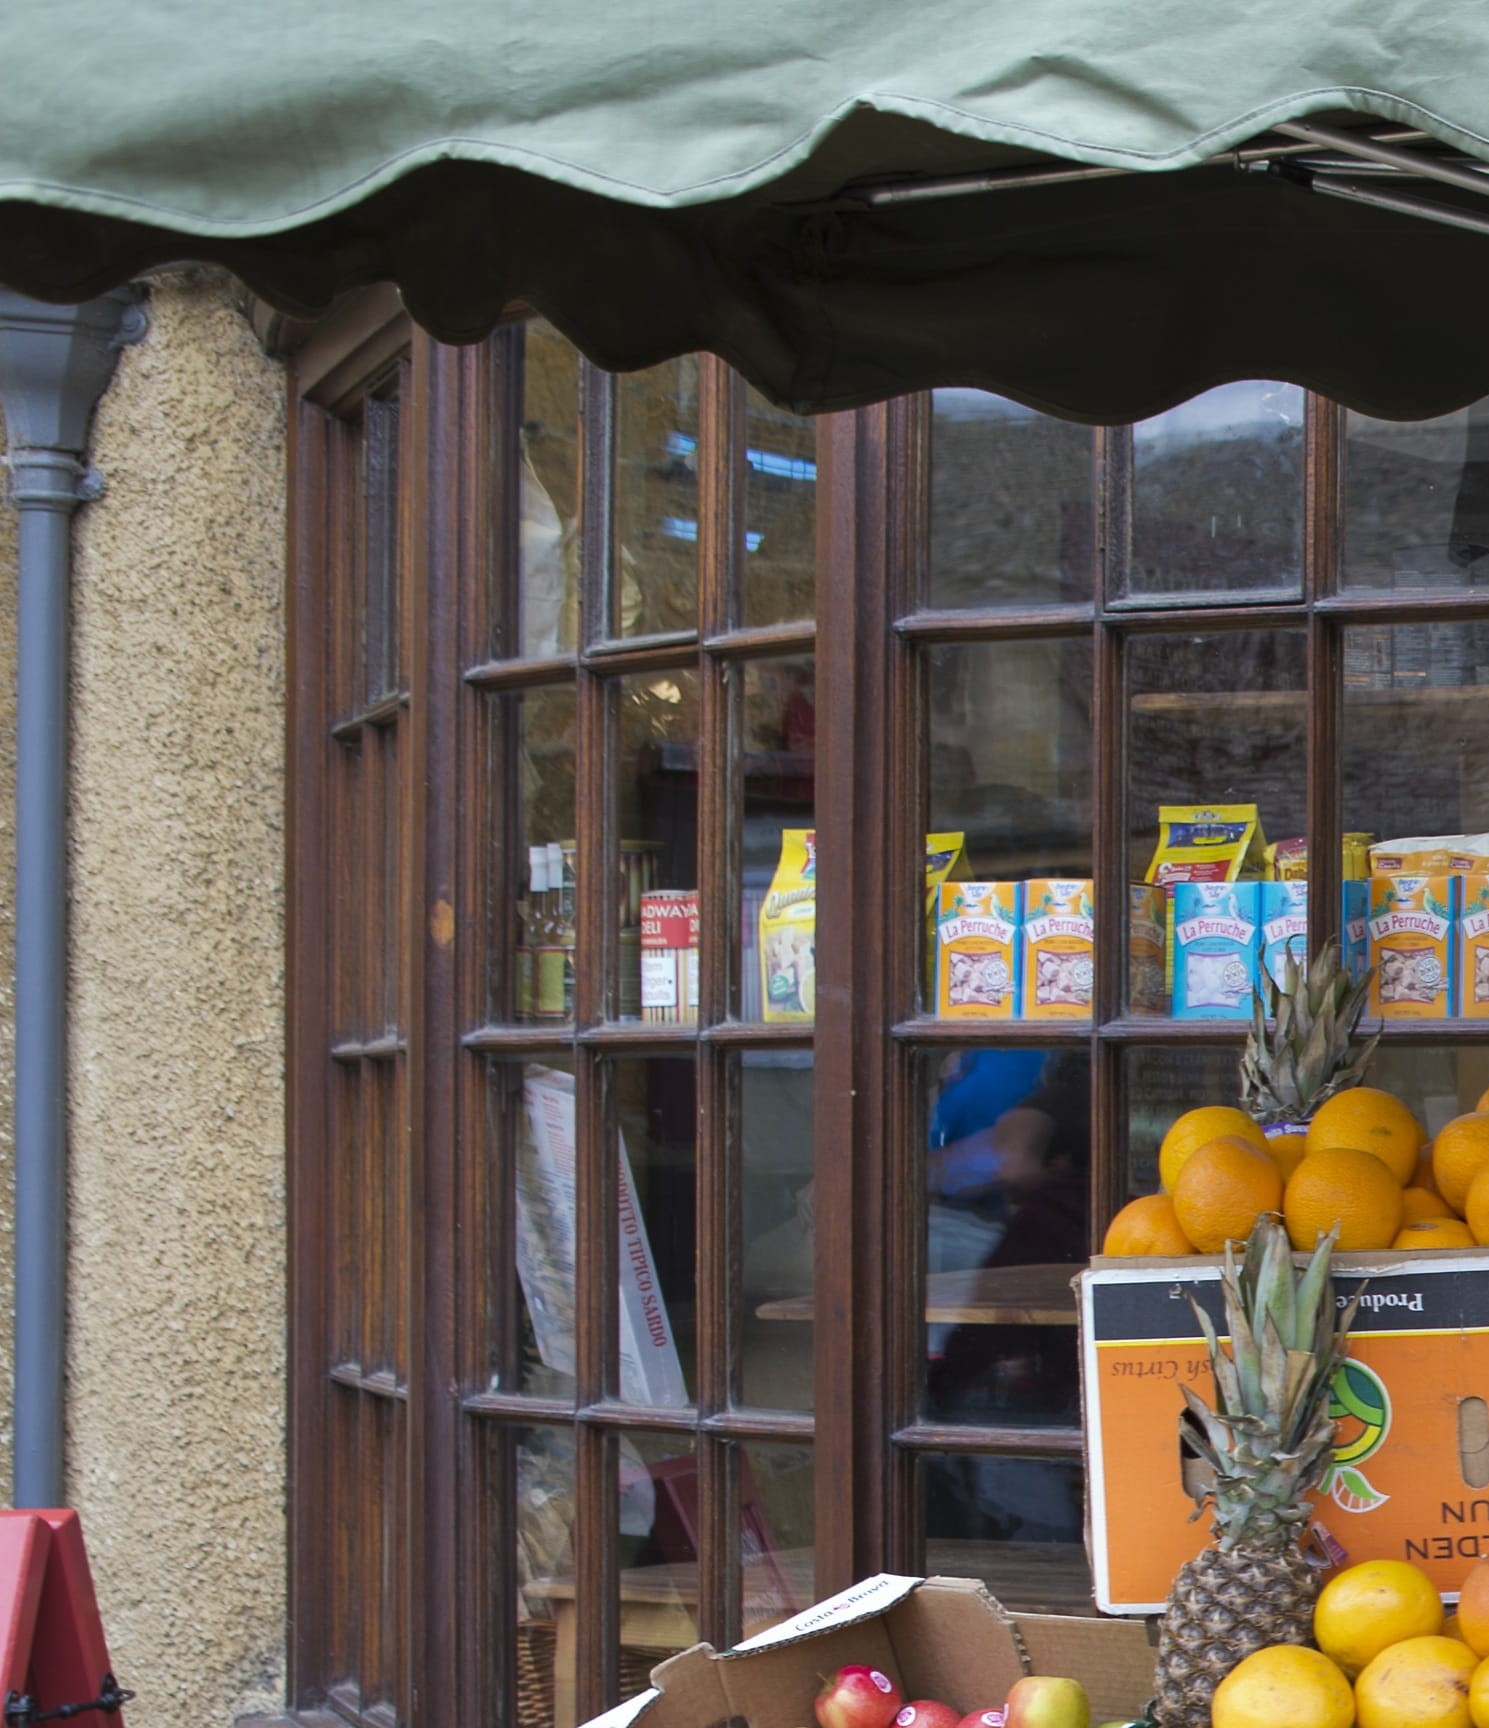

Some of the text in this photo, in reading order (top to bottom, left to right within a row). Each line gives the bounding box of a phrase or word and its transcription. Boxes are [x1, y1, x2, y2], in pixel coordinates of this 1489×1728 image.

[945, 919, 1009, 940] La Perruche
[1032, 923, 1047, 938] La
[1182, 920, 1247, 941] La Perruche
[1270, 924, 1284, 939] La
[1375, 915, 1441, 935] La Perruche
[1470, 918, 1486, 933] La
[627, 1238, 667, 1348] TIPICO SARDO
[795, 1610, 834, 1632] Costa
